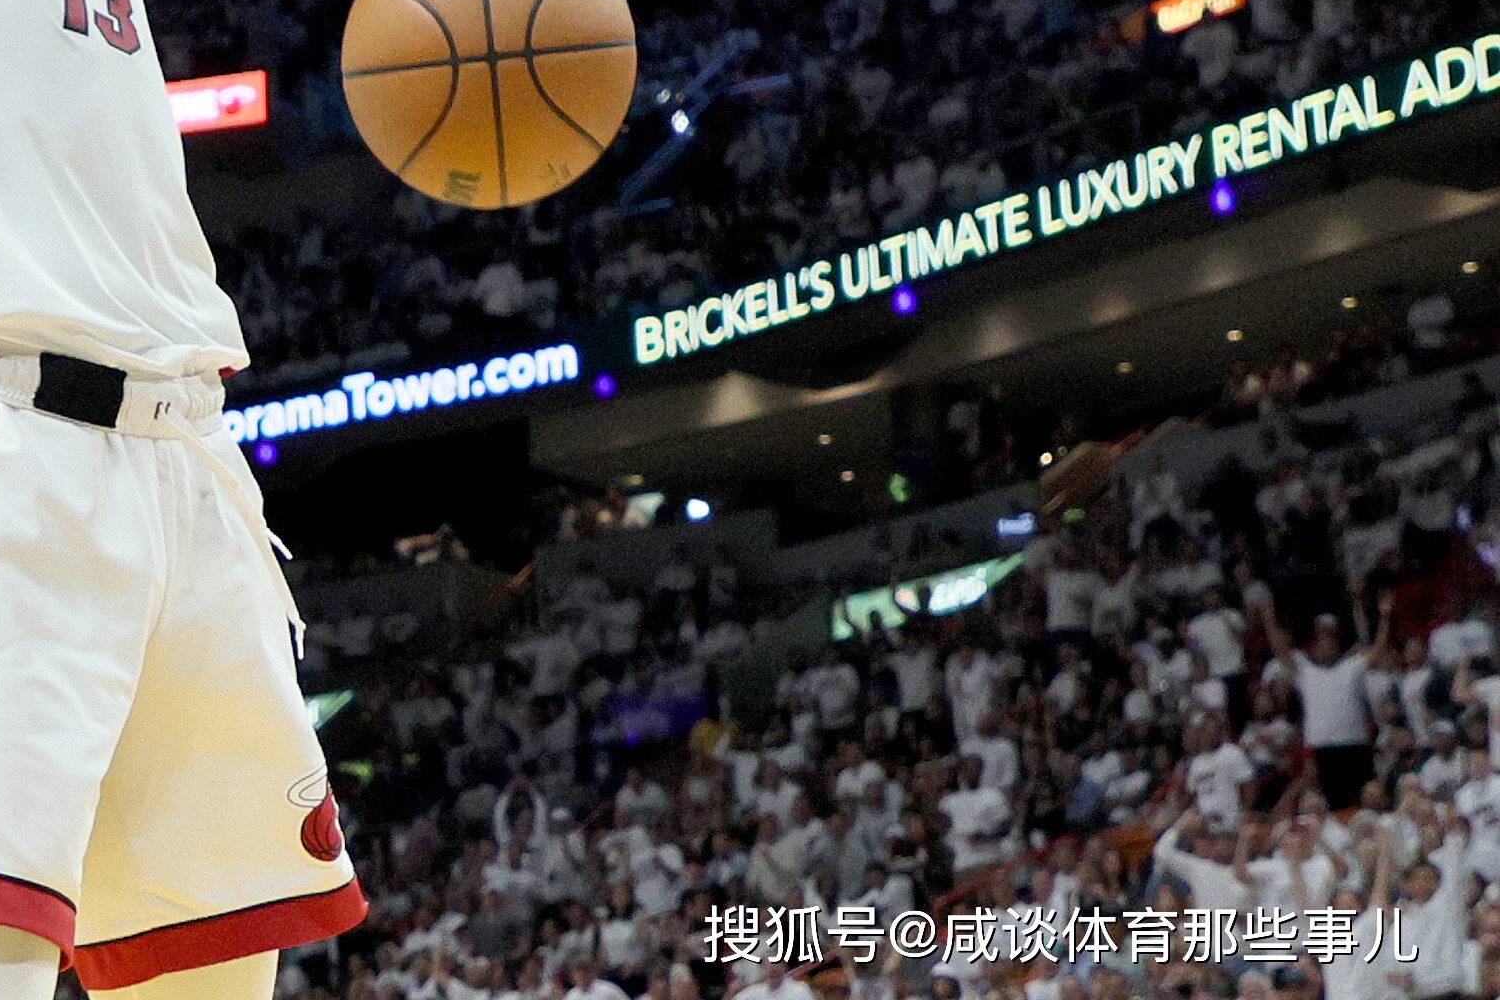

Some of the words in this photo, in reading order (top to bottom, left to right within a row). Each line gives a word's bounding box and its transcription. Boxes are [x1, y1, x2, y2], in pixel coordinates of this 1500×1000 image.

[635, 260, 835, 364] BRICKELL'S
[841, 193, 1032, 299] ULTIMATE
[1038, 134, 1203, 236] LUXURY
[1211, 76, 1396, 178] RENTAL
[220, 343, 579, 443] oramaTower.com
